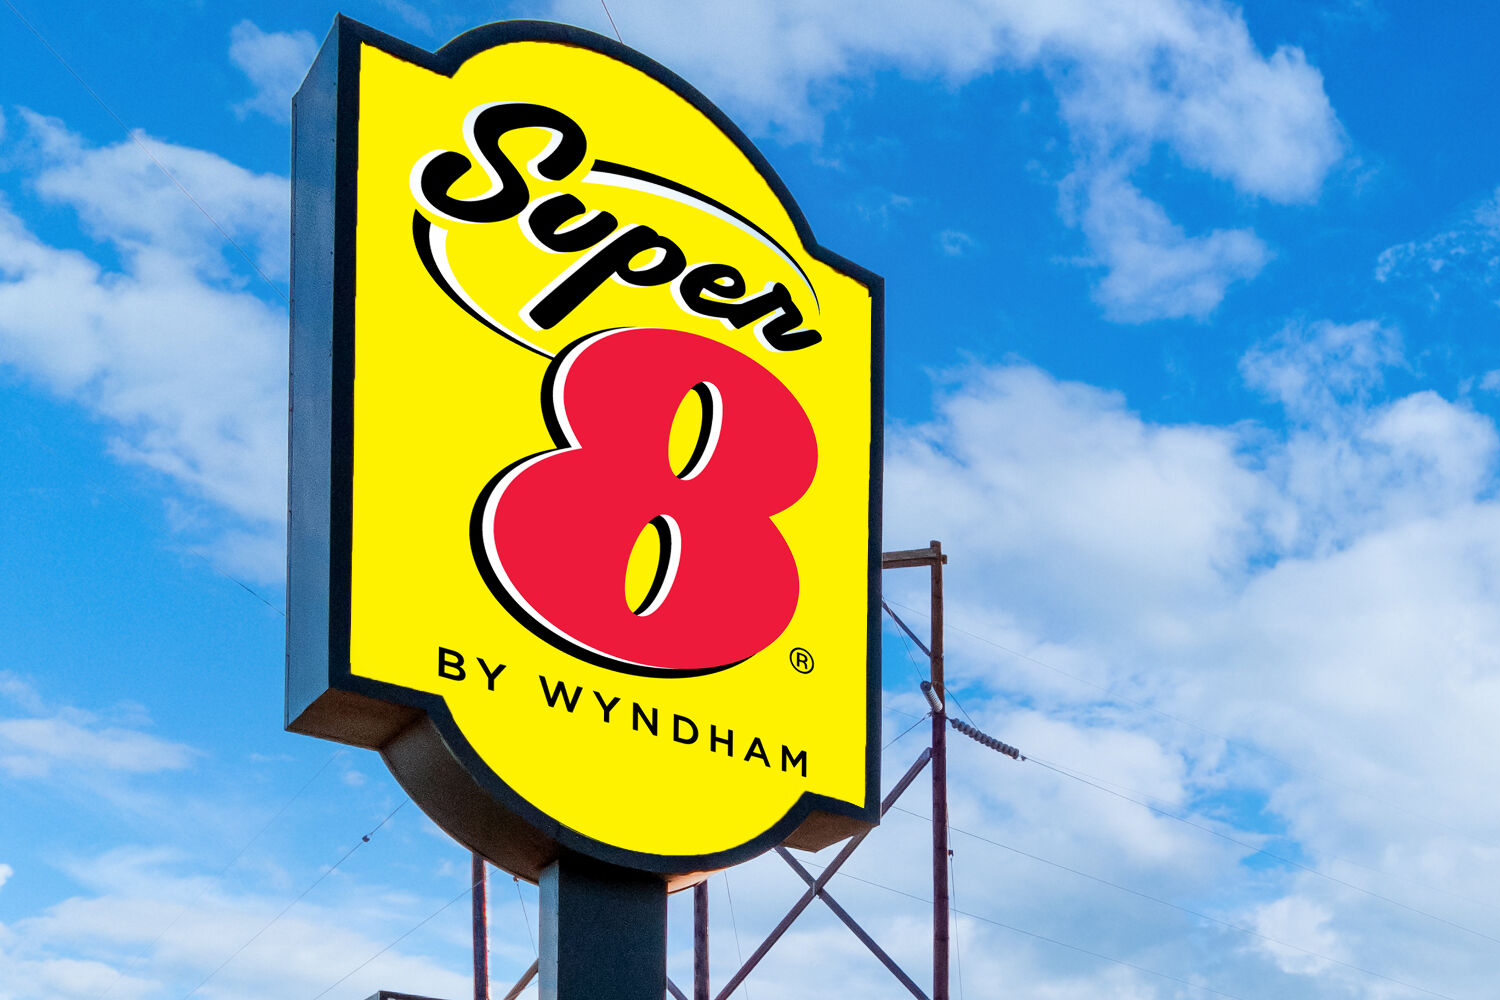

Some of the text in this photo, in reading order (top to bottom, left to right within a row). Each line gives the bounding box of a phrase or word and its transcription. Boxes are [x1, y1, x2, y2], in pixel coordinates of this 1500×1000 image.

[412, 102, 823, 352] Super
[470, 327, 819, 679] 8
[438, 646, 807, 778] BY WYNDHAM
